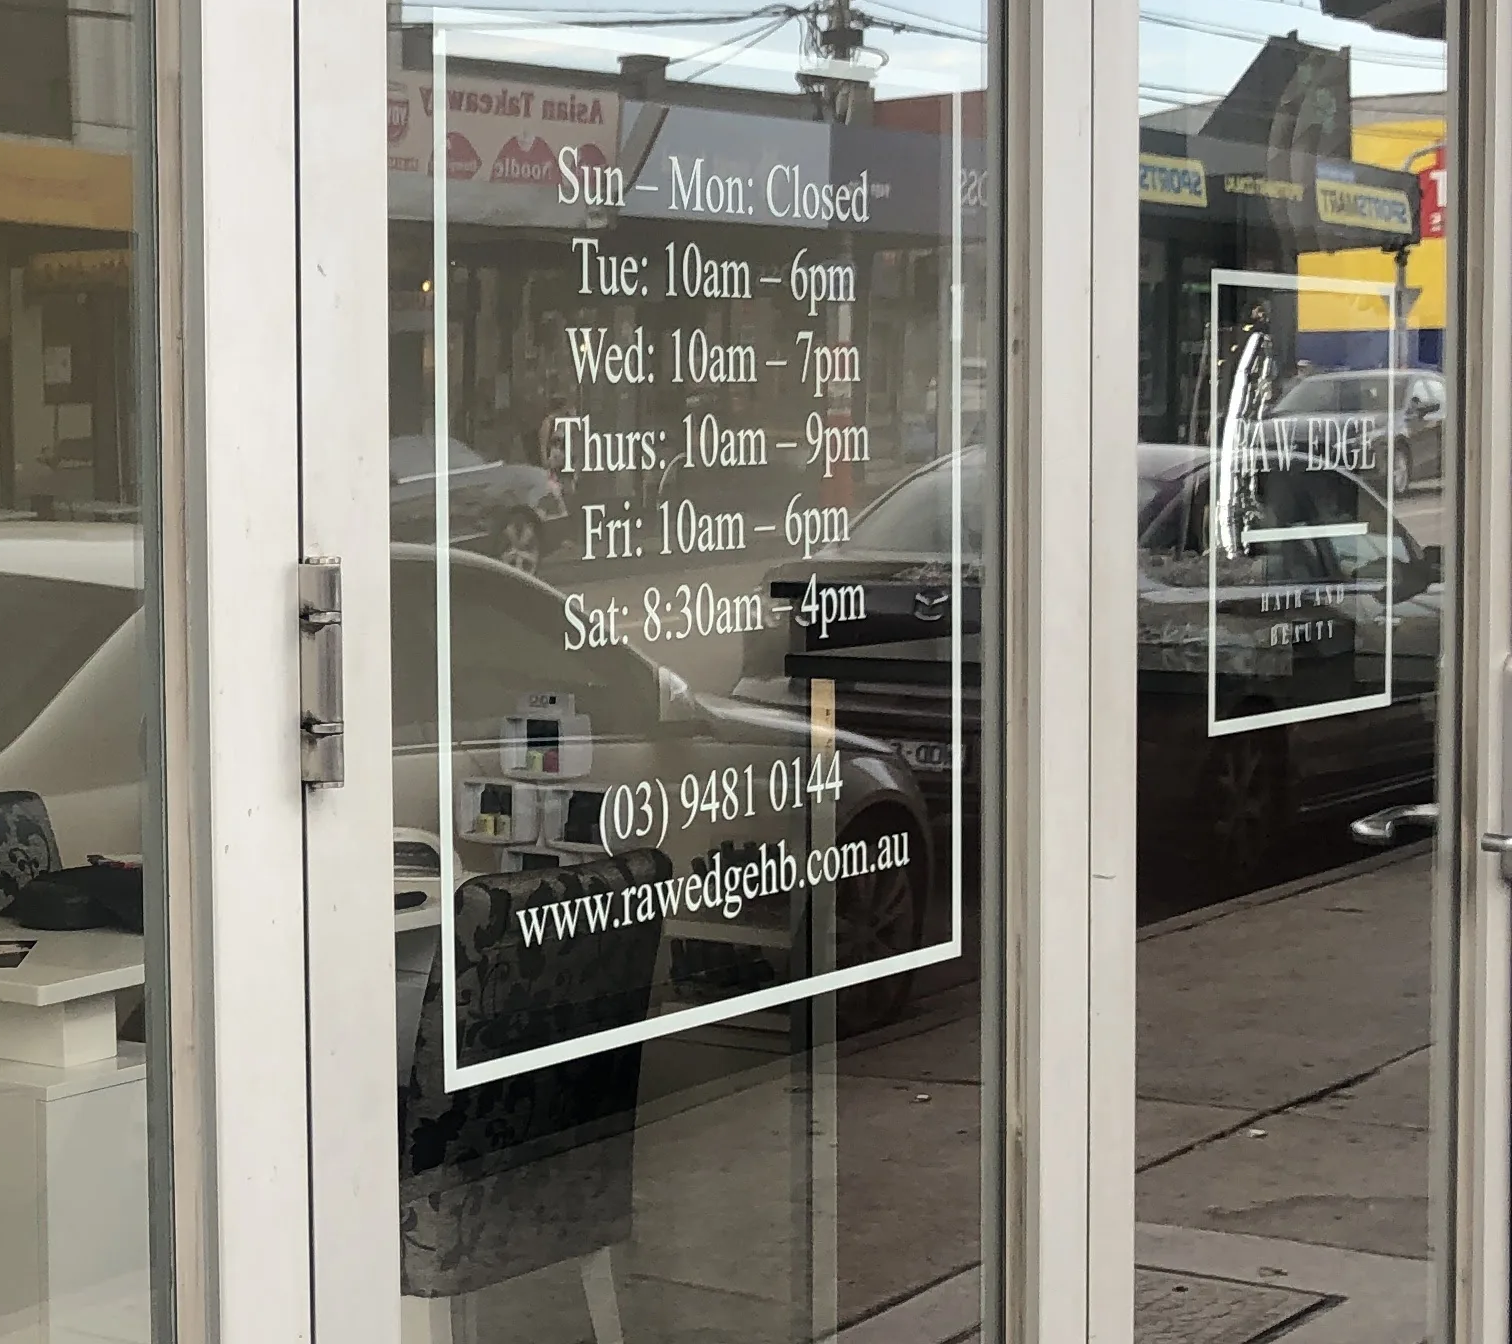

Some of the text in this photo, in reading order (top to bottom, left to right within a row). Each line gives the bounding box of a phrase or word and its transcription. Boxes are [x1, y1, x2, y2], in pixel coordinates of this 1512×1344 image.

[558, 146, 626, 207] Sun
[667, 155, 754, 216] Mon:
[766, 163, 870, 223] Closed
[572, 237, 648, 296] Tue:
[665, 242, 752, 299] 10am
[790, 248, 856, 316] 6pm
[565, 326, 654, 384] Wed:
[671, 328, 758, 383] 10am
[795, 331, 861, 398] 7pm
[554, 414, 666, 473] Thurs:
[682, 413, 768, 468] 10am
[806, 411, 870, 478] 9pm
[1306, 416, 1377, 472] EDGE
[581, 500, 642, 560] Fri:
[659, 499, 746, 555] 10am
[785, 493, 851, 560] 6pm
[564, 593, 629, 651] Sat:
[643, 582, 764, 642] 8:30am
[801, 573, 867, 639] 4pm
[1260, 582, 1347, 613] HAIR AND
[1270, 618, 1335, 647] BEAUTY
[599, 775, 670, 858] (03)
[680, 764, 756, 830] 9481
[769, 750, 843, 812] 0144
[516, 832, 910, 948] www.rawedgehb.com.au
